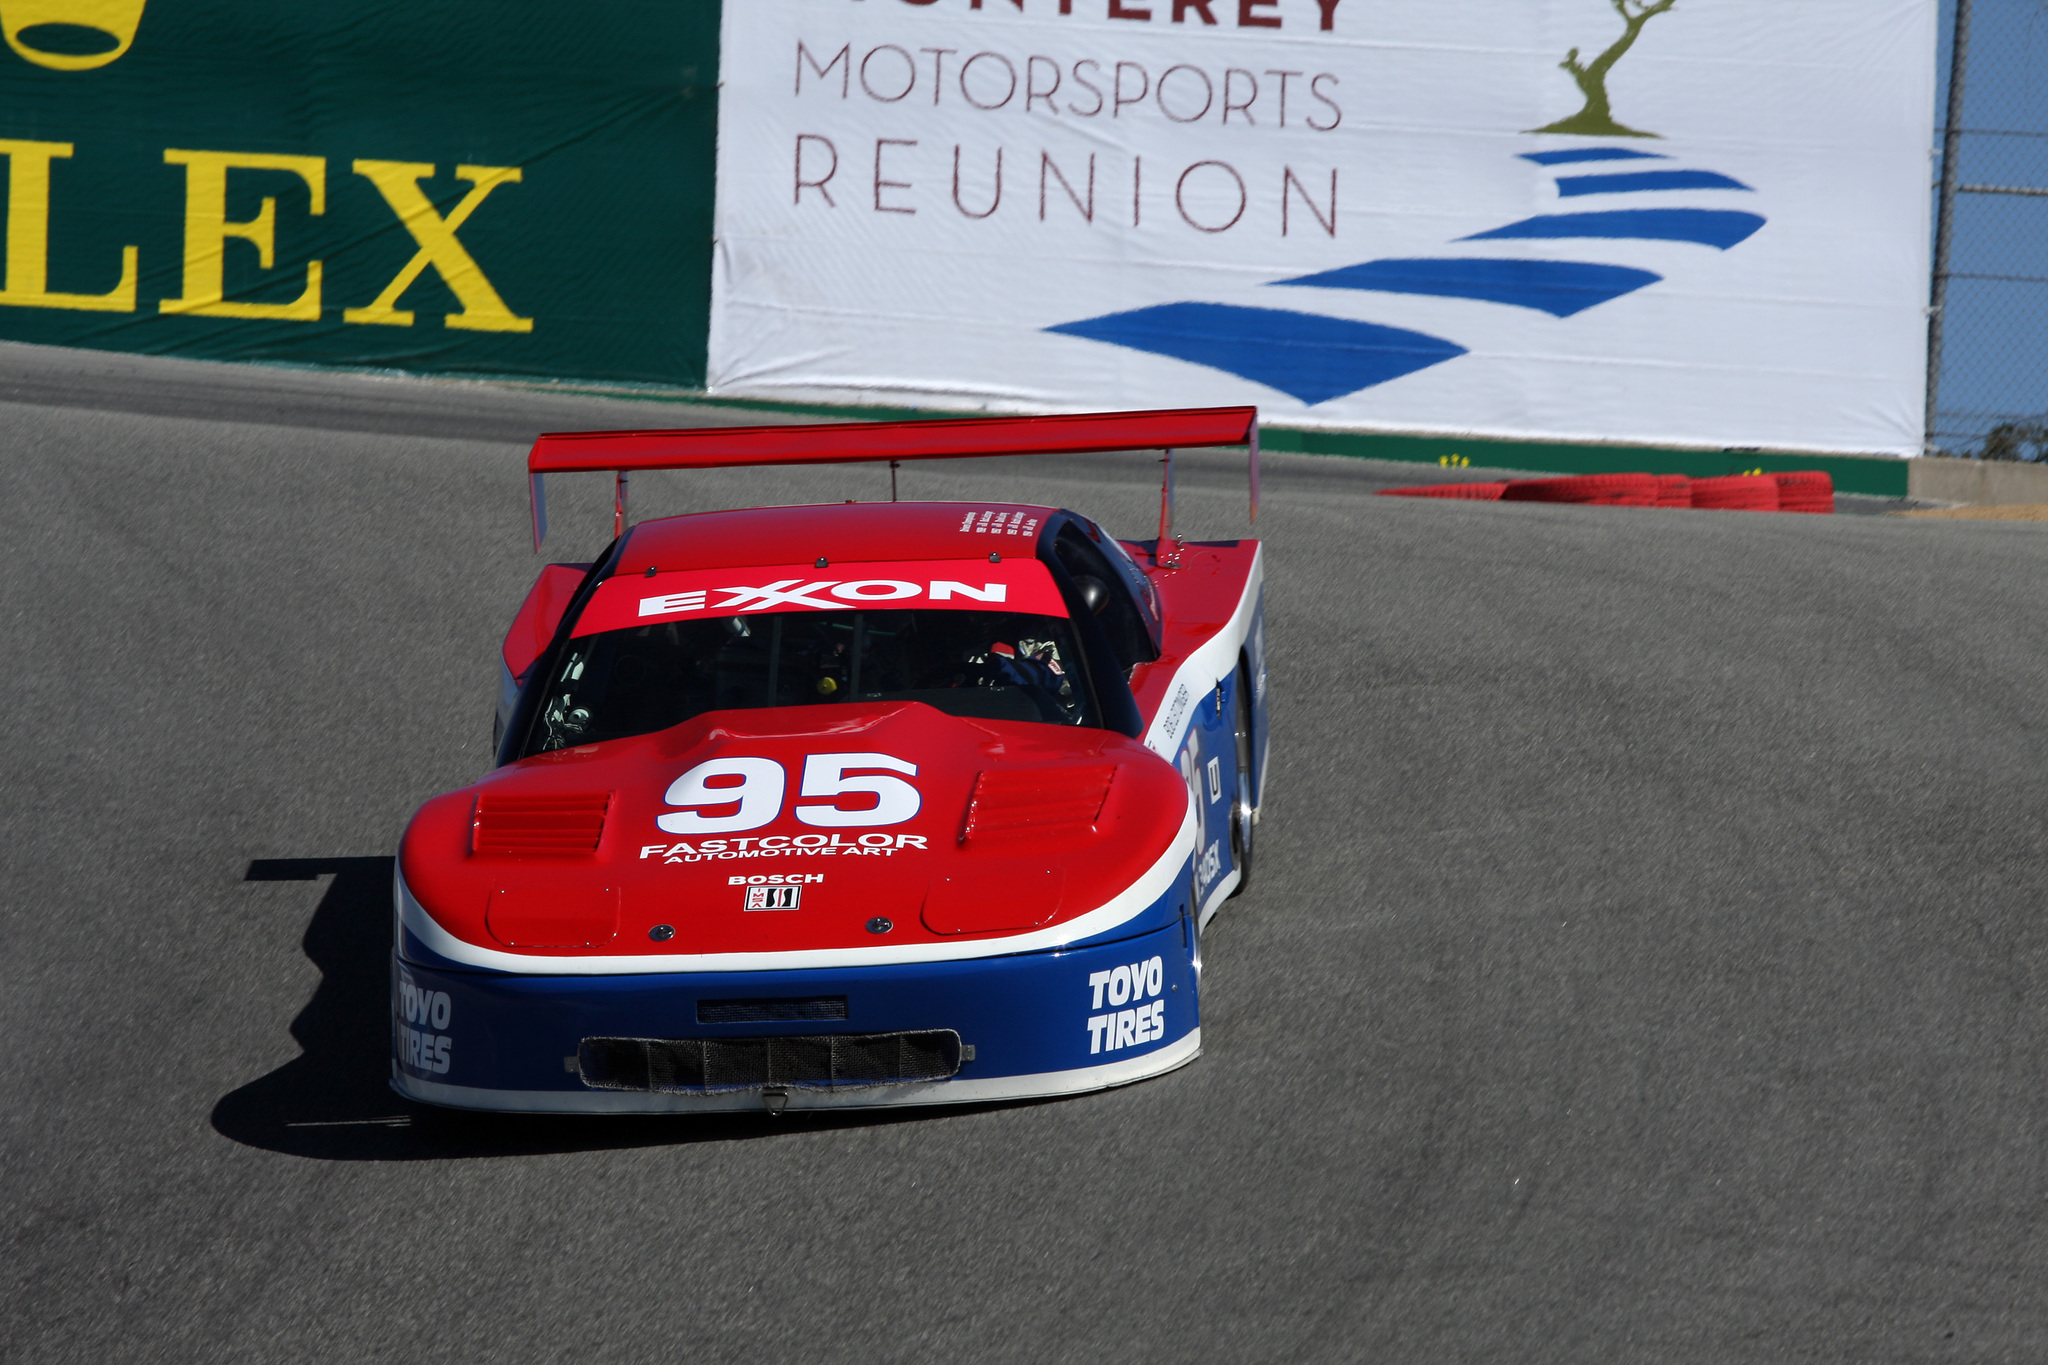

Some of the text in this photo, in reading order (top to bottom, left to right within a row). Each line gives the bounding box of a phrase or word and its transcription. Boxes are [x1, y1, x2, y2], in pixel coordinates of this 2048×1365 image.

[795, 40, 1342, 132] MOTORSPORTS
[794, 134, 1338, 238] REUNION
[638, 579, 1007, 617] EXXON
[656, 752, 922, 835] 95
[639, 833, 928, 859] FASTCOLOR
[664, 847, 898, 865] AUTOMOTIVE ART
[728, 873, 824, 886] BOSCH
[400, 980, 451, 1030] TOYO
[1089, 955, 1163, 1010] TOYO
[400, 1024, 452, 1075] TIRES
[1087, 999, 1165, 1055] TIRES
